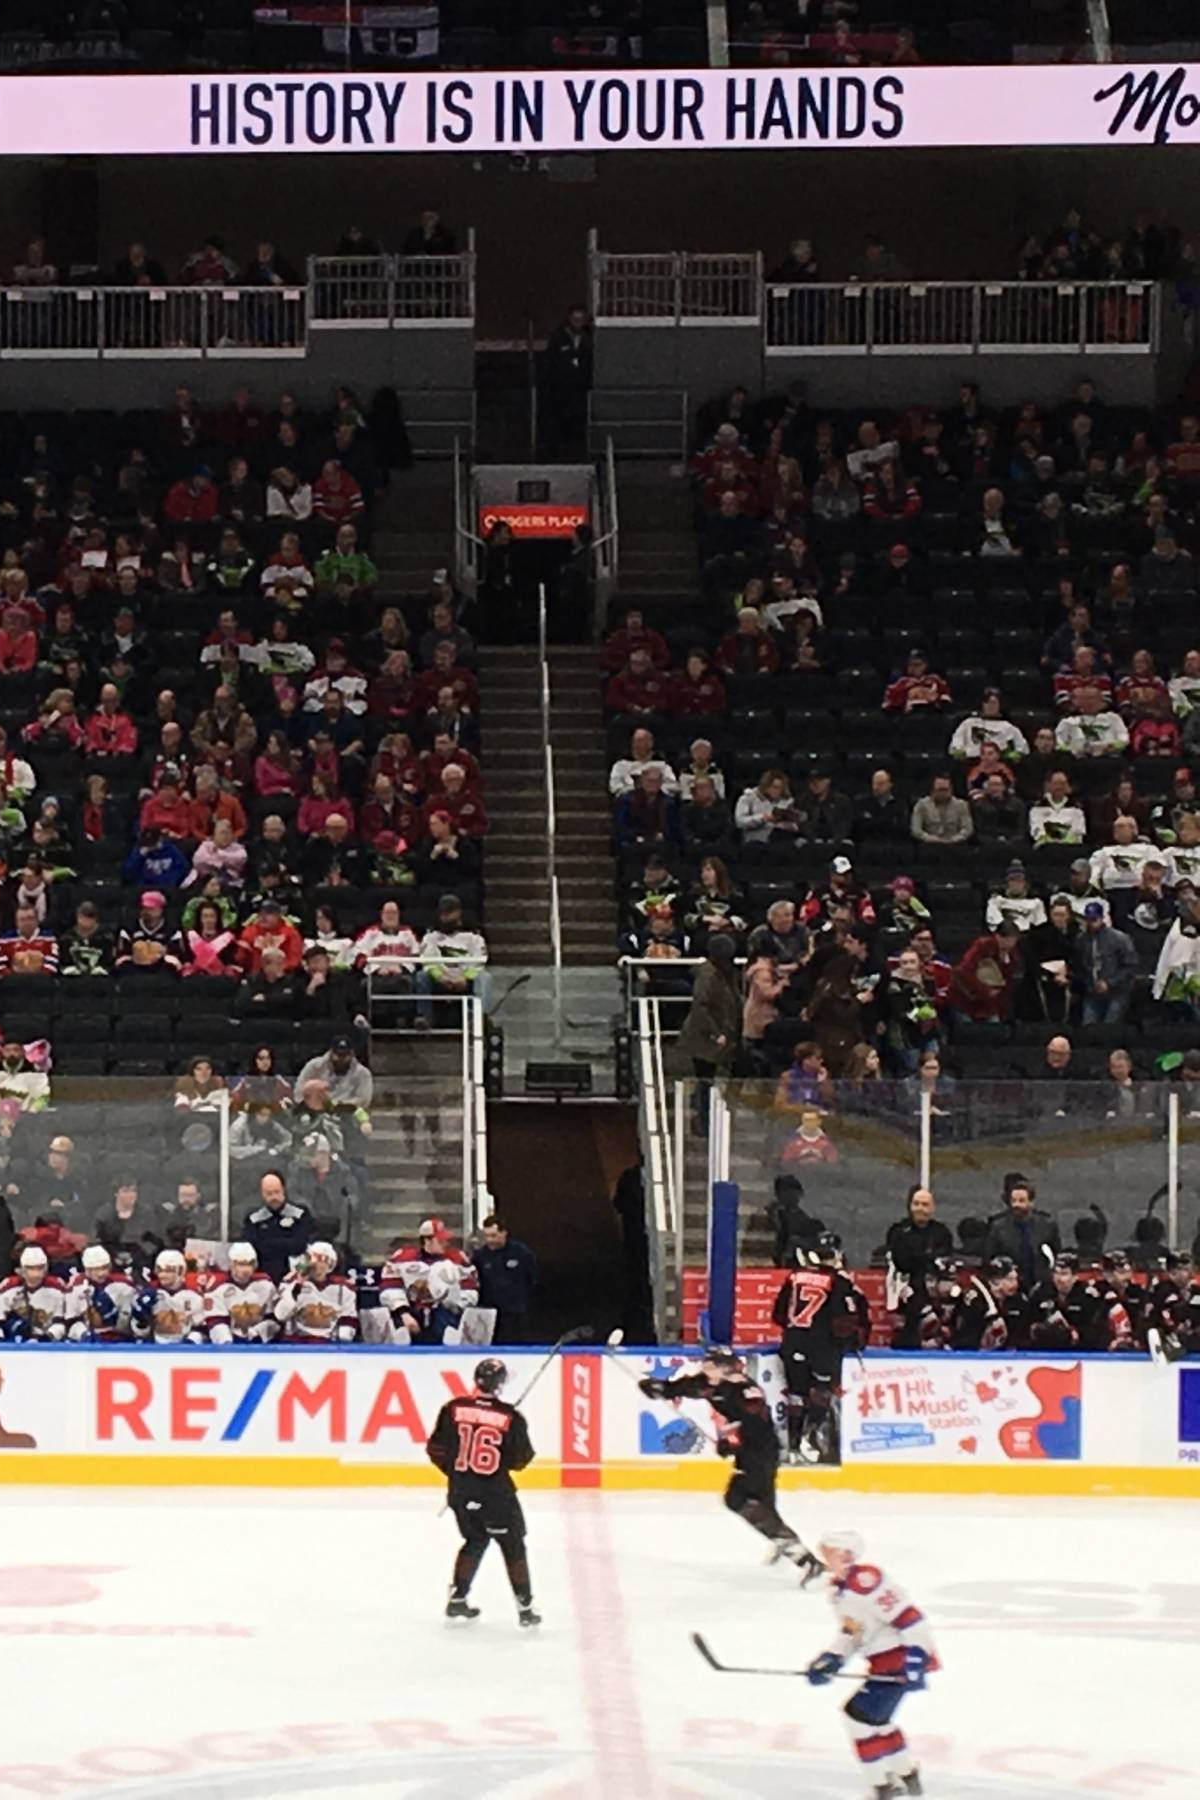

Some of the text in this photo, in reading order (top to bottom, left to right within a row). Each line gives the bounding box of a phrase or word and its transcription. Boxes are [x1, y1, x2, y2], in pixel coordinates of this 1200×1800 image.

[191, 75, 904, 145] HISTORY IS IN YOUR HANDS
[573, 1363, 591, 1459] CCM
[906, 1379, 935, 1398] Hit
[907, 1395, 969, 1416] Music
[454, 1422, 503, 1475] 16
[679, 1715, 1200, 1793] PLCE
